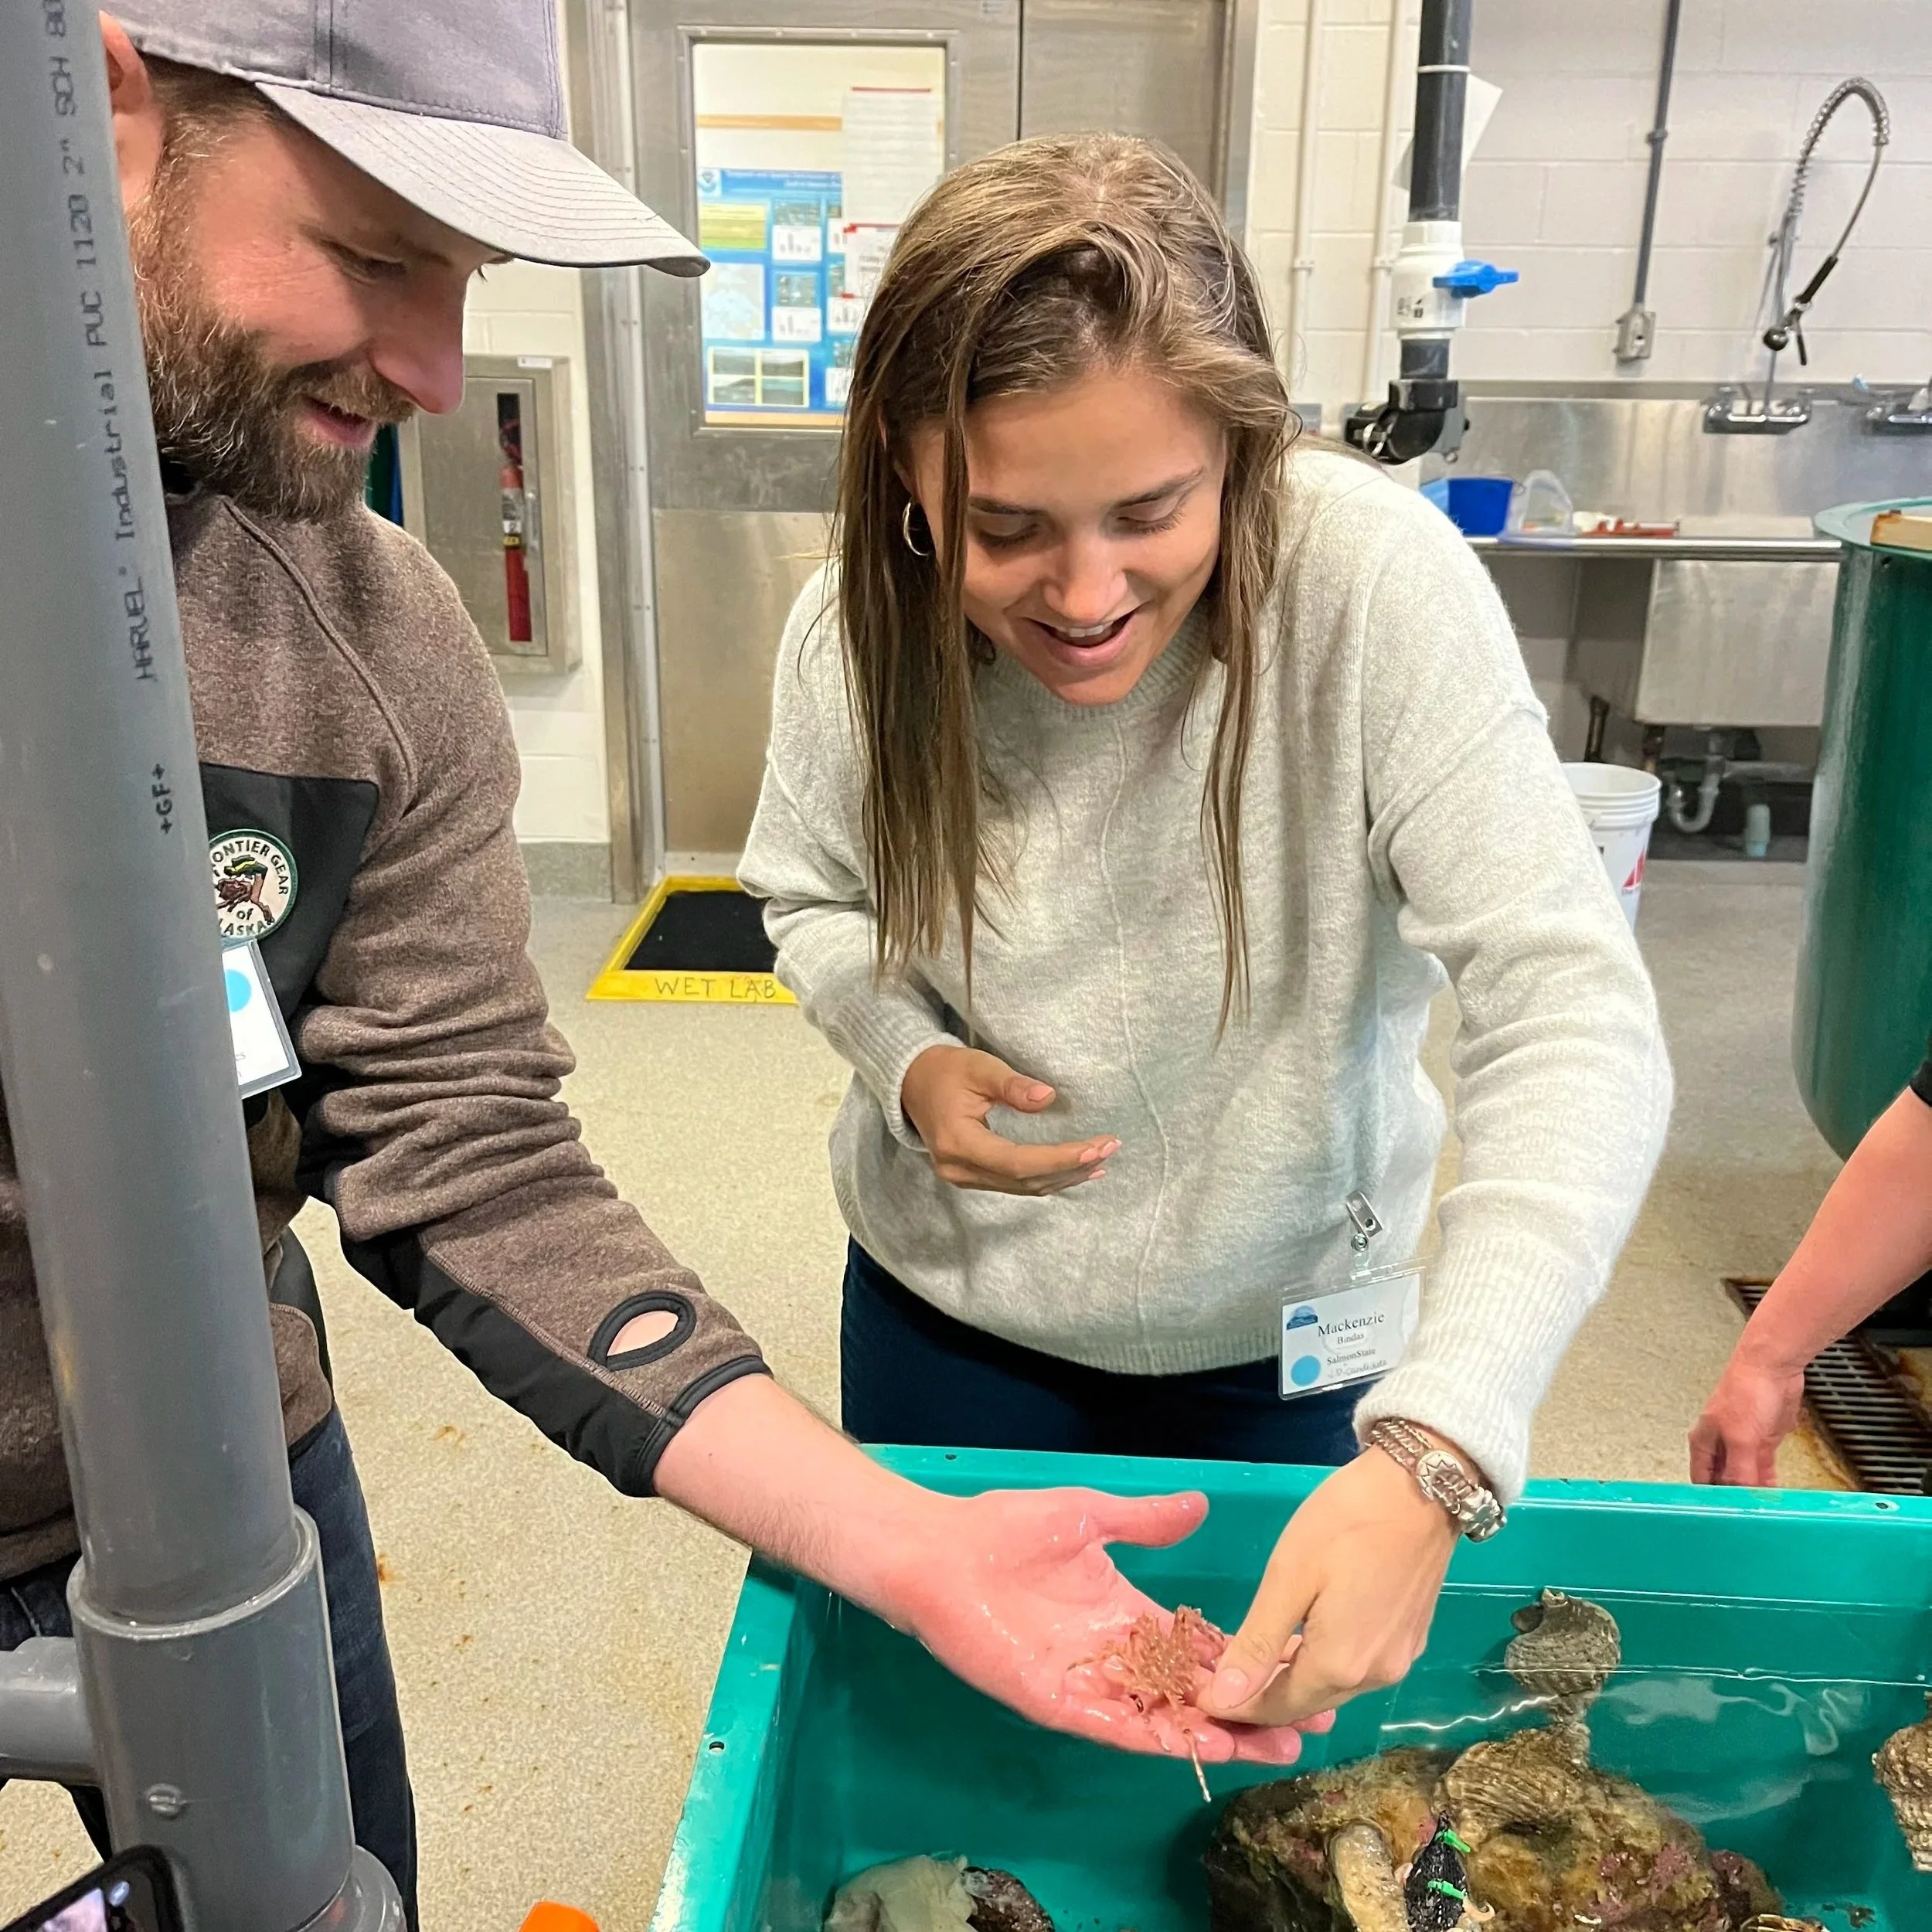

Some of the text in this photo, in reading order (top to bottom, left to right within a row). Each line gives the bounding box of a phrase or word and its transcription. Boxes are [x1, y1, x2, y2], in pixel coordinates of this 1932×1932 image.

[49, 56, 77, 116] SCH
[68, 194, 96, 269] 1120
[94, 370, 134, 539] Industrial
[212, 839, 288, 895] ONTIER GEAR
[236, 907, 254, 920] of
[219, 918, 267, 936] ASKA
[655, 976, 776, 999] WET LAB
[1318, 1311, 1385, 1337] Mackenzie
[1326, 1348, 1376, 1366] SalmonState
